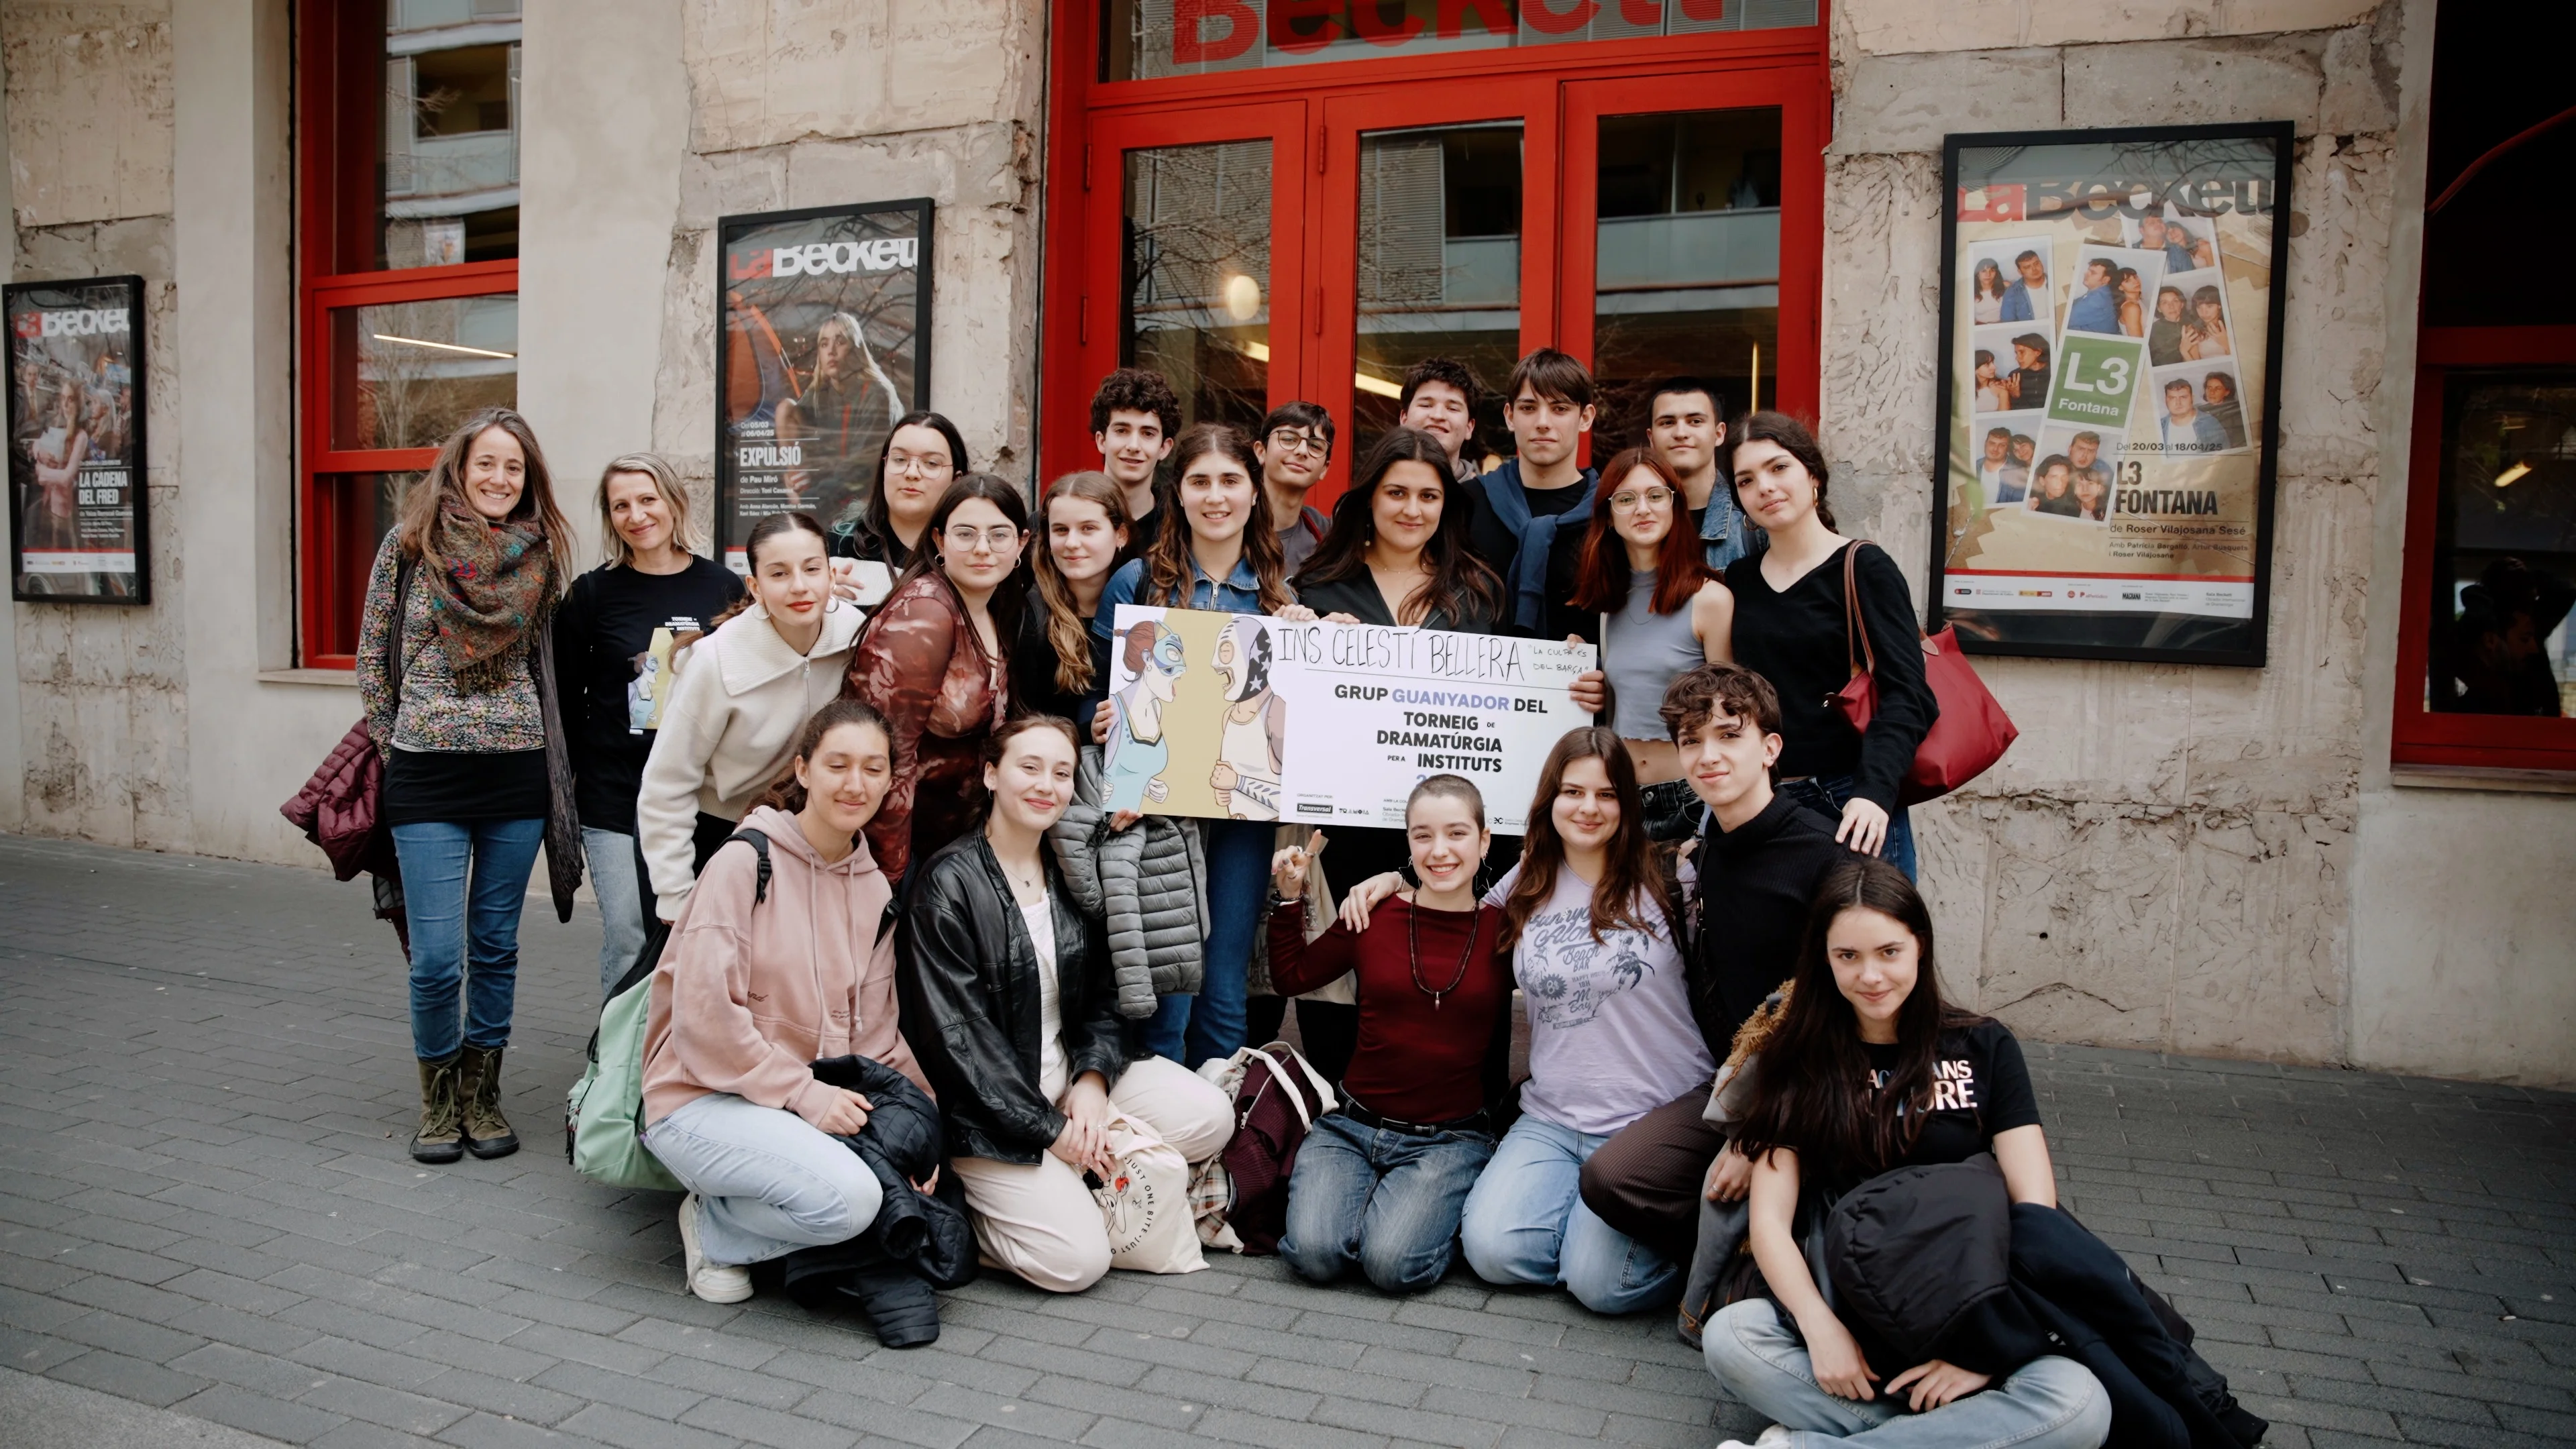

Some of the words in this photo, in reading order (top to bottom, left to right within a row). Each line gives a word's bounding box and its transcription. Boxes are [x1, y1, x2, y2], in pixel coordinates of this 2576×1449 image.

[1957, 184, 2026, 222] La
[2027, 180, 2275, 220] Becket
[773, 237, 918, 277] Becket
[2063, 352, 2129, 395] L3
[2058, 397, 2119, 417] Fontana
[740, 441, 801, 466] EXPULSIÓ
[2116, 443, 2131, 451] Del
[2133, 443, 2164, 451] 20/03
[2166, 443, 2173, 451] al
[2175, 443, 2222, 451] 18/04/25
[78, 472, 91, 488] LA
[92, 472, 128, 488] CADENA
[750, 475, 762, 483] Pau
[763, 475, 778, 483] Miró
[2116, 462, 2142, 485] L3
[78, 490, 96, 504] DEL
[97, 489, 119, 504] FRED
[2115, 490, 2218, 515] FONTANA
[2110, 525, 2123, 533] de
[2127, 525, 2156, 533] Roser
[2160, 525, 2216, 536] Vilajosana
[2219, 525, 2246, 535] Sesé
[1278, 627, 1324, 663] INS.
[1333, 629, 1420, 669] CELESTÍ
[1429, 635, 1524, 681] BELLERA
[1334, 684, 1388, 701] GRUP
[1392, 688, 1509, 711] GUANYADOR
[1513, 698, 1548, 714] DEL
[1403, 711, 1479, 731] TORNEIG
[1377, 729, 1503, 753] DRAMATÚRGIA
[1417, 753, 1502, 773] INSTITUTS
[1298, 804, 1332, 812] Transversal
[1562, 946, 1600, 965] Beach
[1573, 957, 1589, 973] BAR
[1126, 1159, 1146, 1180] JUST
[1144, 1185, 1155, 1205] ONE
[1141, 1210, 1154, 1233] BITE
[1121, 1237, 1140, 1253] JUST
